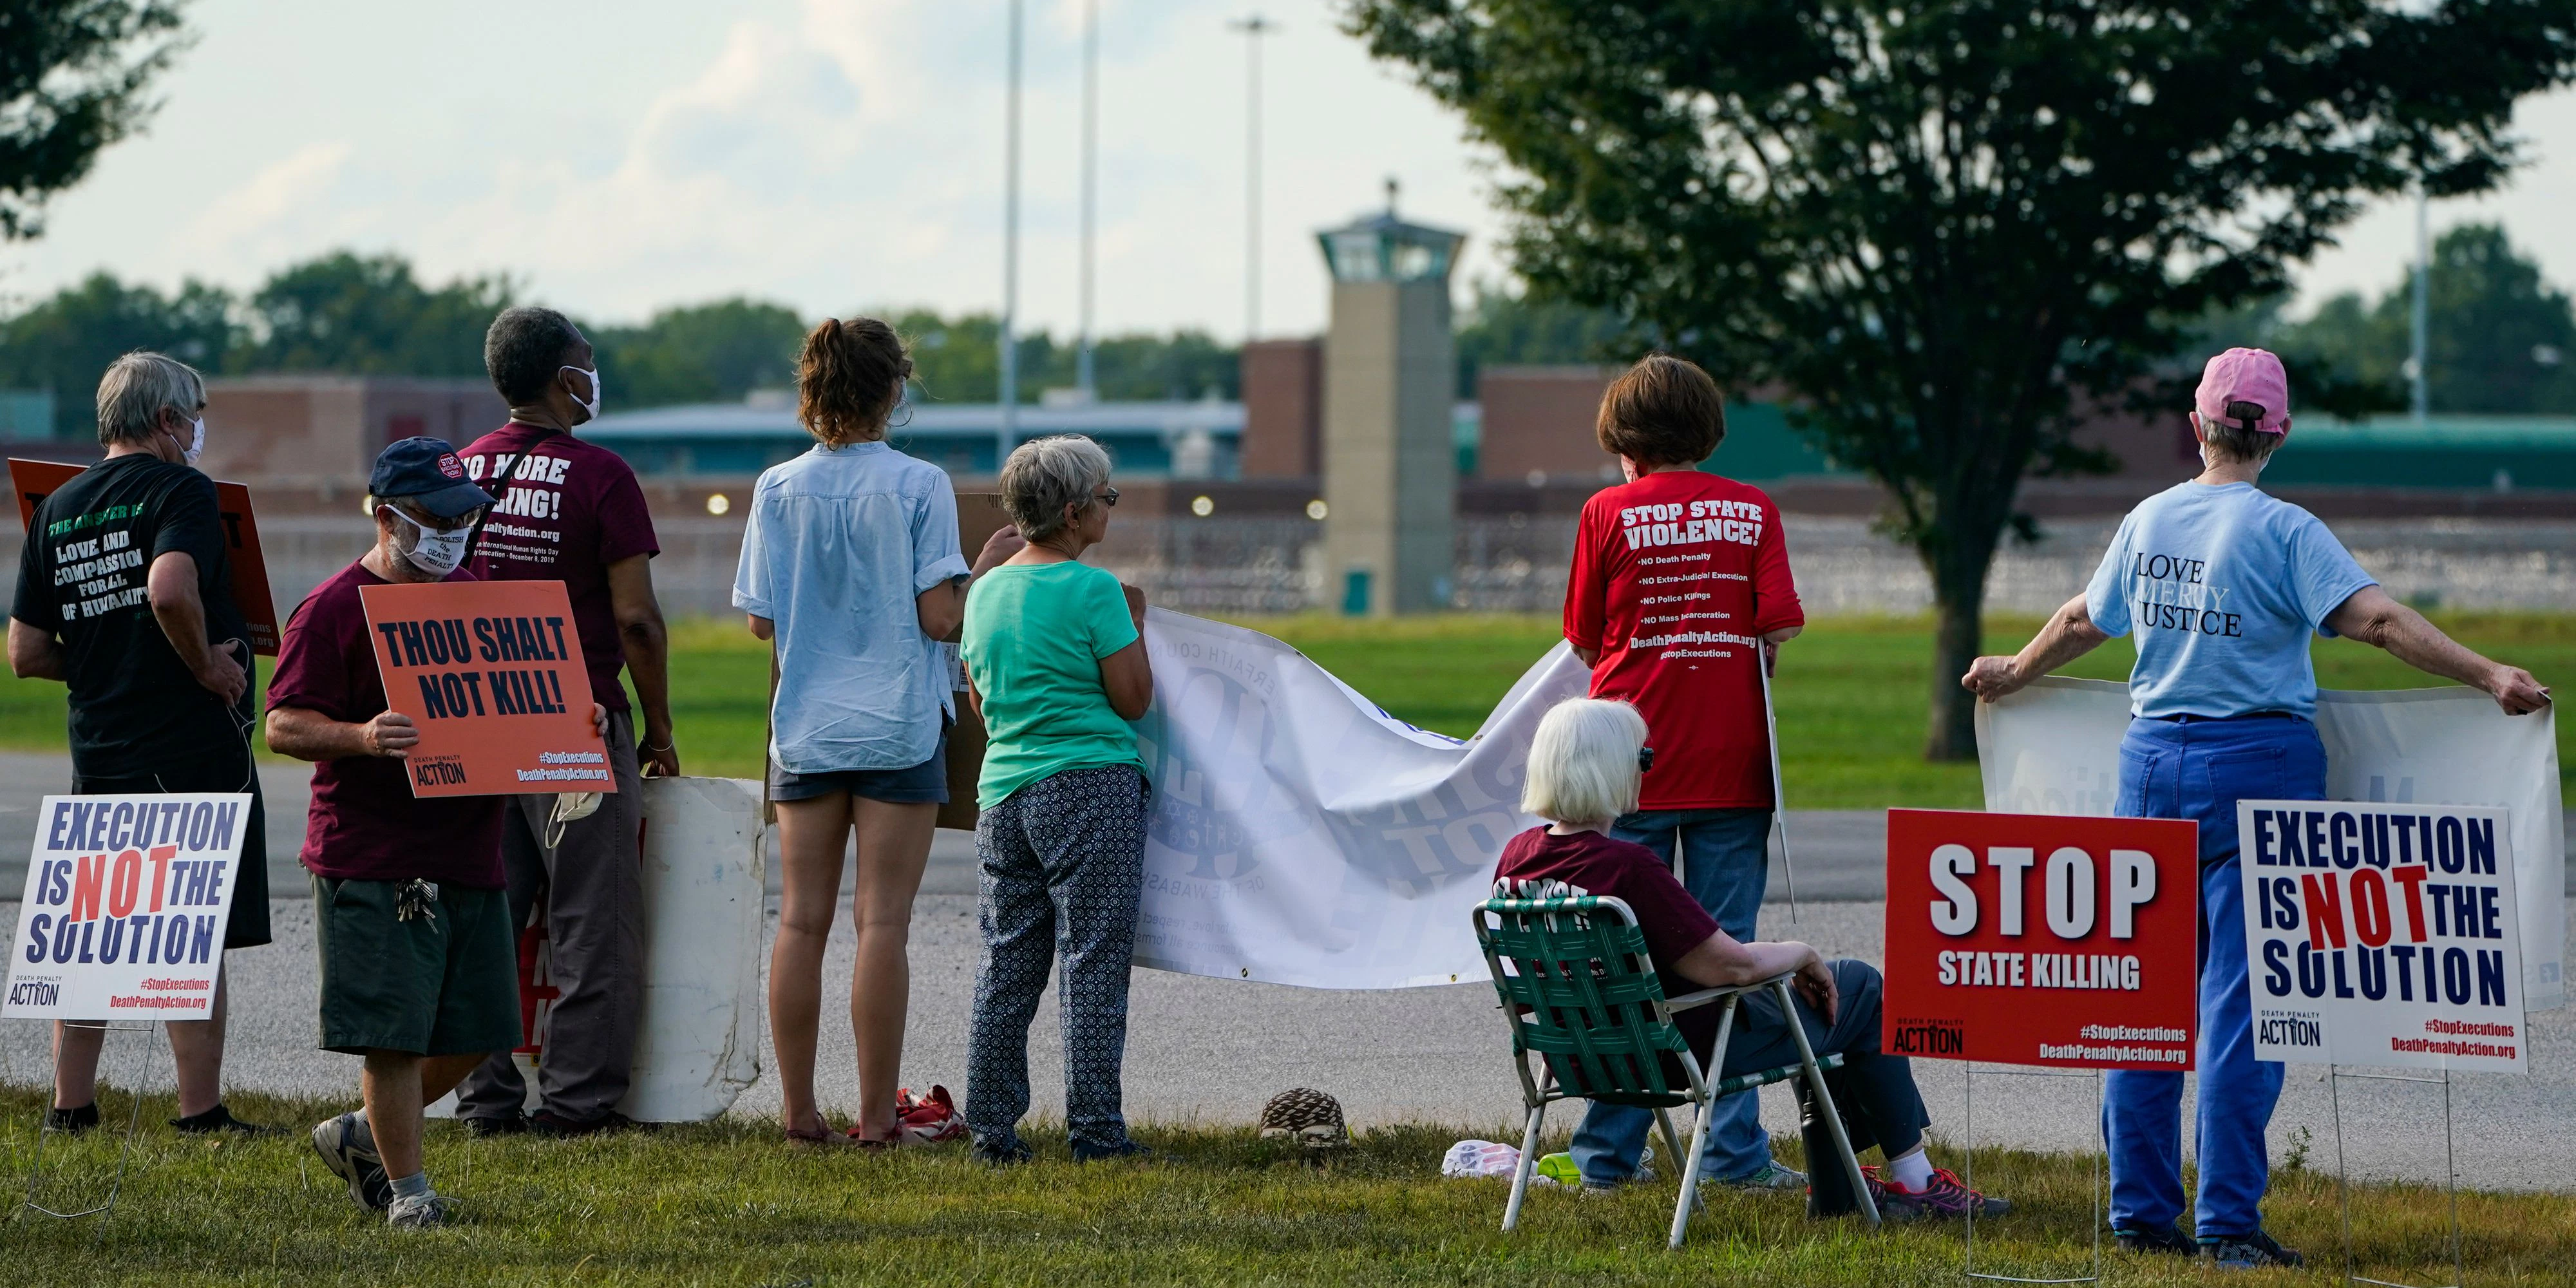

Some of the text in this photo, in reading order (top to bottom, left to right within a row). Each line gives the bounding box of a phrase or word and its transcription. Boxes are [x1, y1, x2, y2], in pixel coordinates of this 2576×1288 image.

[440, 456, 455, 467] STOP
[491, 485, 561, 520] LING!
[1621, 500, 1763, 527] STOP STATE
[48, 518, 71, 537] THE
[131, 502, 144, 517] IS
[482, 522, 560, 542] naltyAction.org
[56, 530, 129, 564] LOVE AND
[439, 542, 450, 553] the
[1624, 519, 1763, 551] VIOLENCE!
[428, 548, 452, 561] DEATH
[509, 553, 533, 562] December
[513, 544, 529, 553] Human
[531, 546, 547, 554] Rights
[1656, 555, 1680, 564] Death
[1681, 553, 1710, 563] Penalty
[55, 549, 143, 586] COMPASSION
[1712, 572, 1748, 581] Execution
[2137, 553, 2204, 583] LOVE
[79, 578, 107, 597] FOR
[1658, 594, 1682, 603] Police
[1684, 592, 1710, 601] Killings
[2137, 580, 2229, 612] MERCY
[62, 603, 77, 621] OF
[2137, 600, 2242, 638] USTICE
[377, 616, 568, 667] THOU SHALT
[417, 669, 566, 719] NOT KILL!
[539, 751, 604, 766] #StopExecutions
[415, 760, 466, 786] ACTION
[516, 769, 609, 782] DeathPenaltyAction.org
[47, 802, 238, 851] EXECUTION
[2253, 810, 2496, 875] EXECUTION
[36, 845, 226, 922] IS NOT THE
[1929, 844, 2156, 939] STOP
[2258, 865, 2502, 951] IS NOT THE
[26, 914, 216, 965] SOLUTION
[1938, 951, 2140, 990] STATE KILLING
[2263, 940, 2506, 1007] SOLUTION
[9, 981, 59, 1006] ACTION
[140, 978, 209, 991] #StopExecutions
[109, 996, 206, 1010] DeathPenaltyAction.org
[1893, 1025, 1963, 1054] ACTION
[2081, 1025, 2186, 1043] #StopExecutions
[2260, 1018, 2320, 1047] ACTION
[2425, 1019, 2514, 1037] #StopExecutions
[2040, 1043, 2186, 1064] DeathPenaltyAction.org
[2392, 1037, 2515, 1059] DeathPenaltyAction.org
